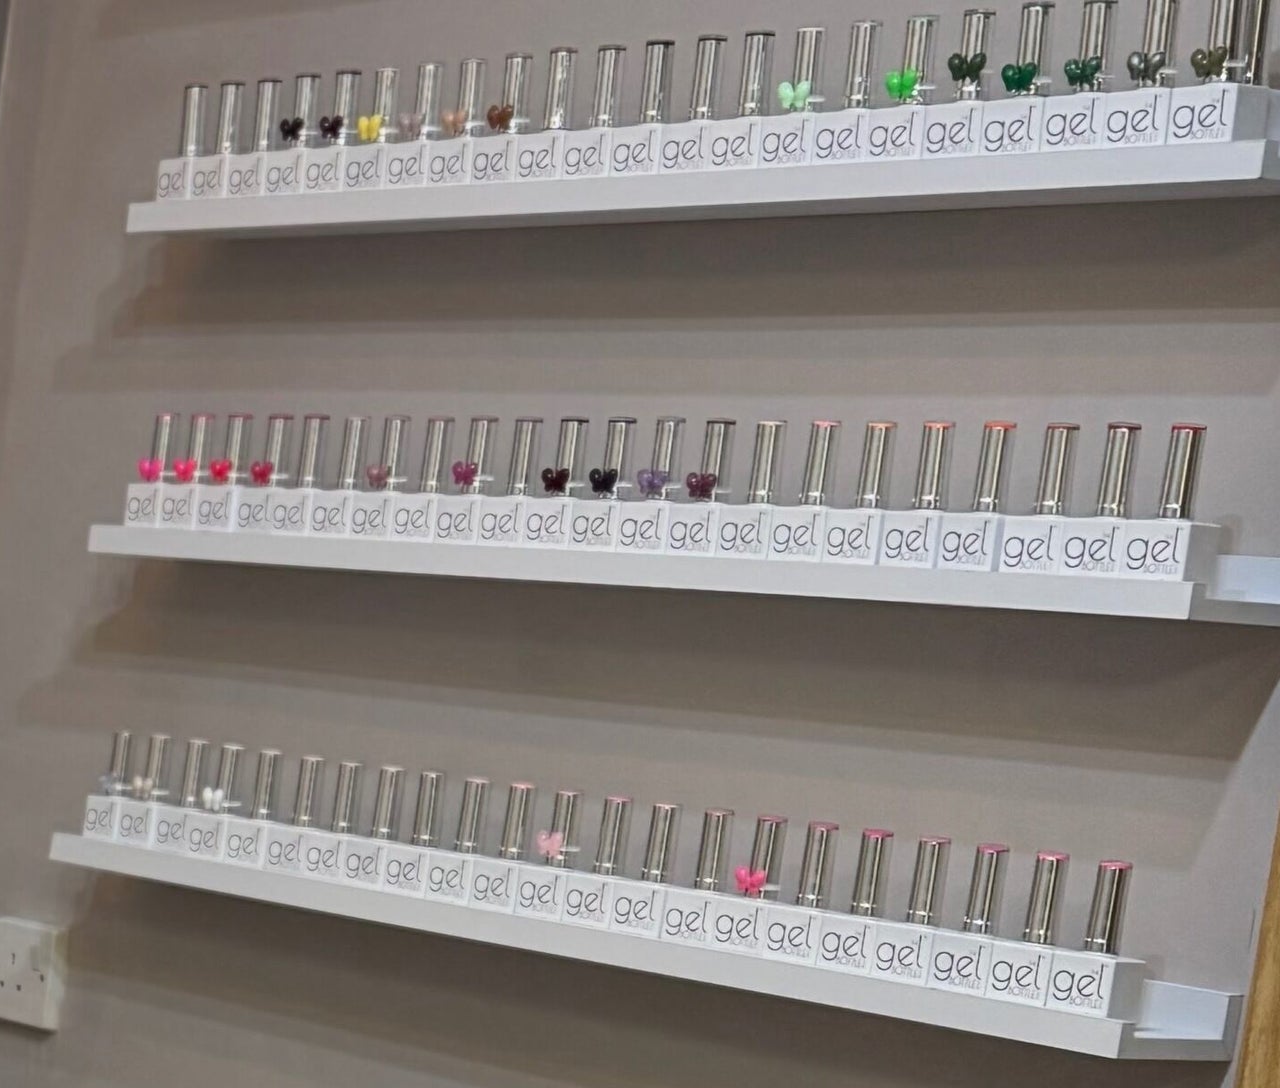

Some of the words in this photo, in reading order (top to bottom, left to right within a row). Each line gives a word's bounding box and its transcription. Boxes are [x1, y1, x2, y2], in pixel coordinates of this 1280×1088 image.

[927, 108, 974, 153] gel
[985, 106, 1033, 151] gel
[1047, 98, 1097, 145] gel
[1107, 94, 1158, 142] gel
[1173, 89, 1227, 138] gel
[614, 130, 653, 172] gel
[662, 127, 703, 168] gel
[712, 123, 753, 165] gel
[763, 119, 805, 162] gel
[815, 115, 860, 158] gel
[870, 112, 915, 156] gel
[307, 152, 339, 189] gel
[347, 149, 380, 186] gel
[389, 144, 424, 184] gel
[430, 143, 465, 182] gel
[473, 141, 510, 180] gel
[519, 137, 555, 177] gel
[565, 134, 603, 175] gel
[159, 161, 187, 197] gel
[193, 159, 222, 195] gel
[229, 157, 260, 194] gel
[267, 154, 299, 192] gel
[128, 489, 157, 521] gel
[162, 489, 192, 521] gel
[199, 492, 229, 524] gel
[238, 494, 269, 527] gel
[273, 495, 305, 529] gel
[313, 496, 346, 531] gel
[352, 499, 387, 533] gel
[395, 500, 430, 534] gel
[437, 501, 473, 538] gel
[481, 502, 518, 540] gel
[527, 504, 565, 540] gel
[573, 506, 612, 542] gel
[620, 508, 661, 546] gel
[670, 511, 711, 549] gel
[721, 511, 762, 550] gel
[773, 513, 817, 552] gel
[828, 515, 870, 556] gel
[885, 518, 929, 558] gel
[943, 521, 987, 561] gel
[1004, 525, 1054, 567] gel
[1065, 526, 1115, 568] gel
[1127, 527, 1179, 570] gel
[86, 802, 113, 830] gel
[120, 808, 148, 837] gel
[157, 814, 187, 843] gel
[190, 821, 220, 852] gel
[228, 828, 259, 858] gel
[269, 835, 302, 865] gel
[307, 841, 340, 871] gel
[346, 846, 379, 878] gel
[387, 854, 422, 885] gel
[430, 861, 464, 892] gel
[474, 868, 510, 900] gel
[520, 875, 557, 908] gel
[566, 883, 605, 916] gel
[615, 890, 655, 924] gel
[666, 901, 707, 935] gel
[716, 908, 759, 942] gel
[768, 915, 812, 951] gel
[822, 925, 867, 961] gel
[876, 935, 923, 970] gel
[934, 946, 982, 981] gel
[992, 955, 1040, 991] gel
[1053, 964, 1103, 1000] gel
